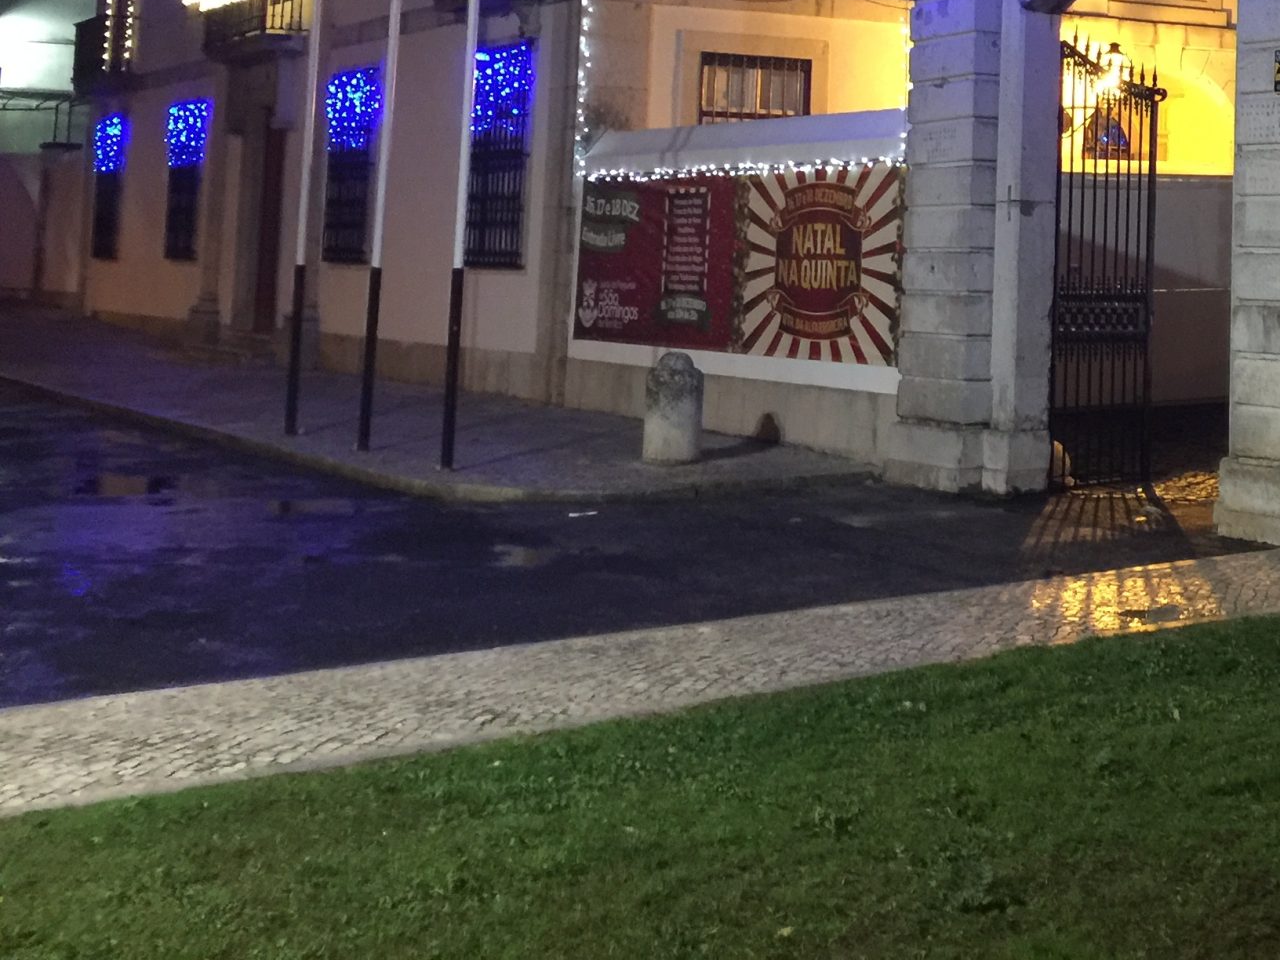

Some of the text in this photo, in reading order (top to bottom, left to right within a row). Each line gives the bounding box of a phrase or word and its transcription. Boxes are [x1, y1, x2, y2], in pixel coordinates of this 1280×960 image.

[792, 222, 846, 258] NATAL
[778, 259, 858, 291] NA QUINTA
